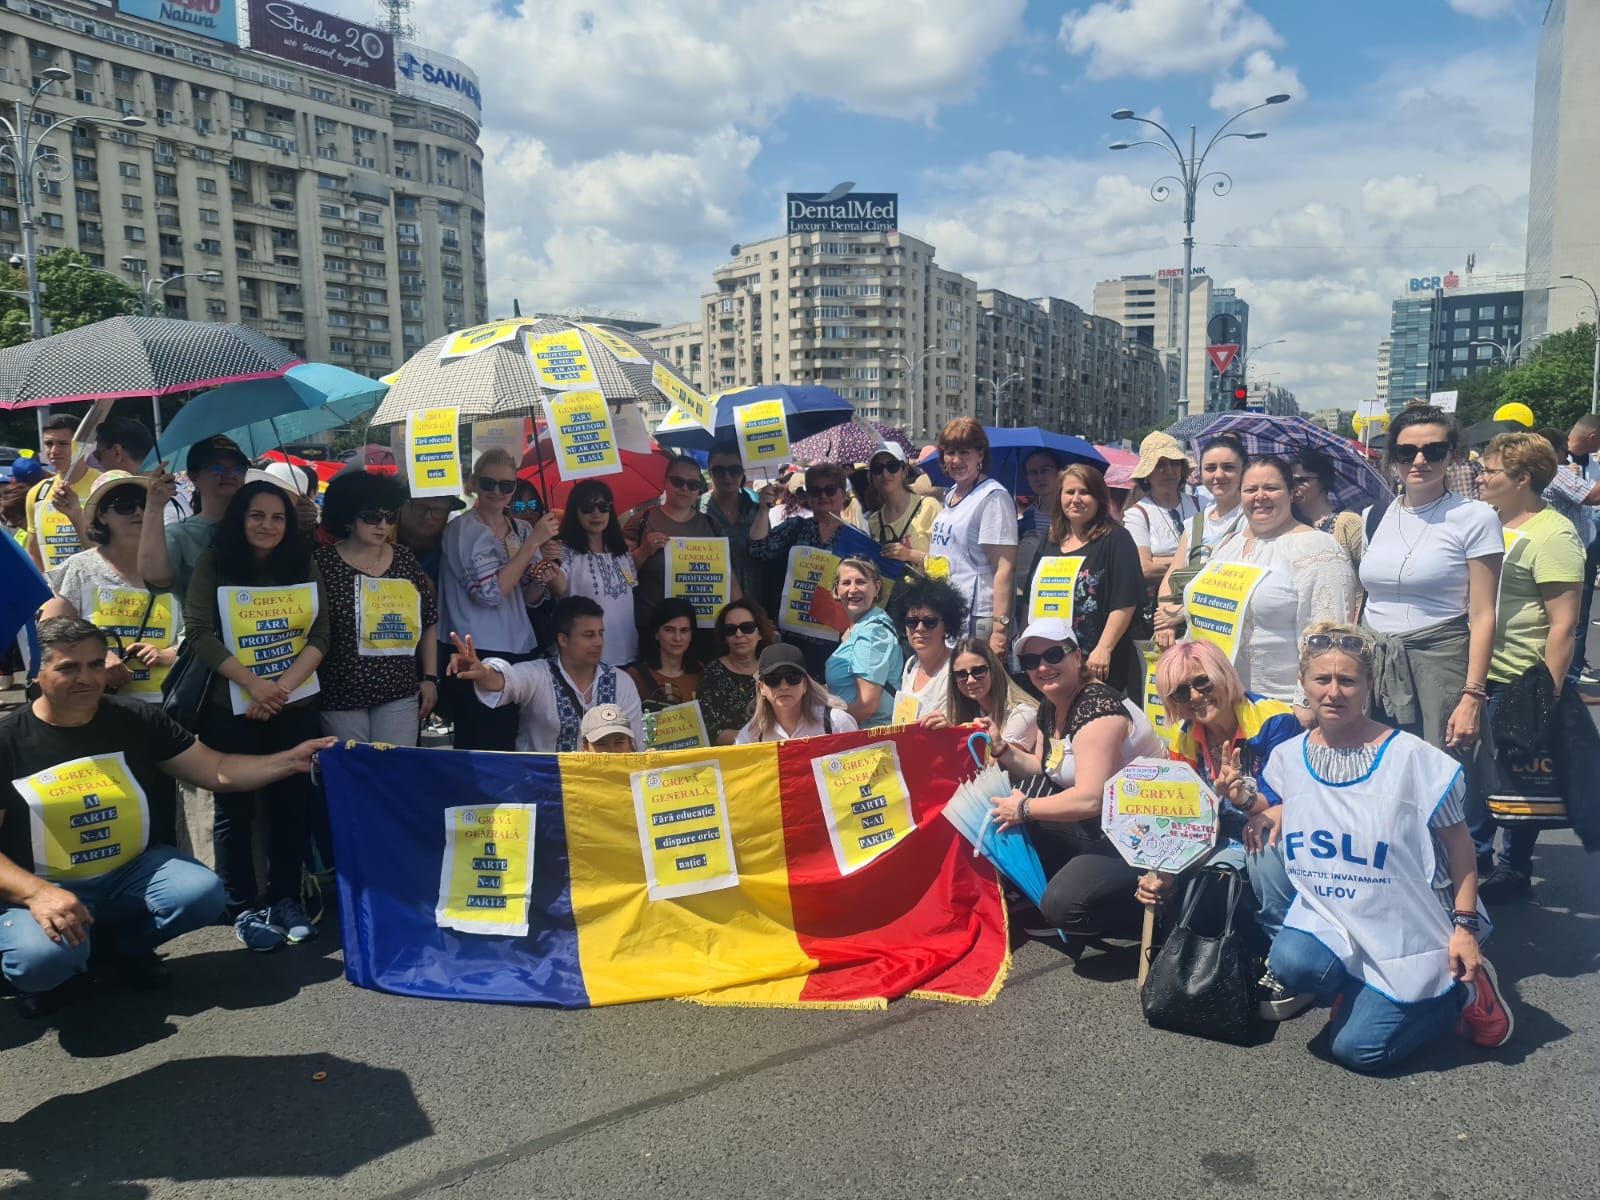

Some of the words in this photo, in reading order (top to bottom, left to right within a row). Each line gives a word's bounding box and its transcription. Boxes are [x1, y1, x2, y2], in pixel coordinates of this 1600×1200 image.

[159, 2, 217, 28] Natura
[265, 3, 342, 43] Studio
[344, 28, 384, 59] 20
[336, 52, 369, 68] together
[790, 200, 896, 219] DentalMed
[1158, 266, 1206, 278] FIRSTNK
[1409, 276, 1441, 292] BCR
[562, 421, 605, 434] PROFESORI
[677, 574, 722, 582] PROFESORI
[686, 584, 713, 593] LUMEA
[115, 596, 146, 606] GREV
[253, 593, 294, 607] GREVĂ
[238, 604, 305, 619] GENERALĂ
[254, 643, 294, 661] LUMEA
[263, 662, 279, 674] AR
[280, 657, 297, 669] AV
[654, 720, 695, 737] ENERALĂ
[842, 750, 882, 771] GREVĂ
[58, 767, 105, 782] GREVĂ
[662, 772, 700, 788] GREVĂ
[834, 764, 889, 788] GENERALĂ
[48, 776, 120, 798] GENERALĂ
[651, 785, 710, 804] GENERALĂ
[860, 785, 872, 796] AI
[1139, 788, 1185, 800] GREVĂ
[85, 794, 99, 808] AI
[852, 796, 887, 814] CARTE
[1125, 803, 1197, 816] GENERALĂ
[71, 807, 117, 828] CARTE
[478, 814, 512, 825] GREVĂ
[652, 812, 675, 826] Fără
[862, 814, 884, 829] N-AI
[80, 828, 109, 843] N-AI
[464, 827, 520, 840] GENERALĂ
[662, 831, 696, 848] dispare
[697, 829, 720, 841] orice
[859, 829, 895, 848] PARTE!
[71, 843, 120, 864] PARTE!
[485, 845, 496, 855] AI
[1285, 830, 1389, 870] FSLI
[473, 859, 507, 870] CARTE
[678, 857, 701, 870] nație
[477, 876, 500, 888] N-AI
[1314, 885, 1357, 900] ILFOV
[467, 896, 507, 908] PARTE!
